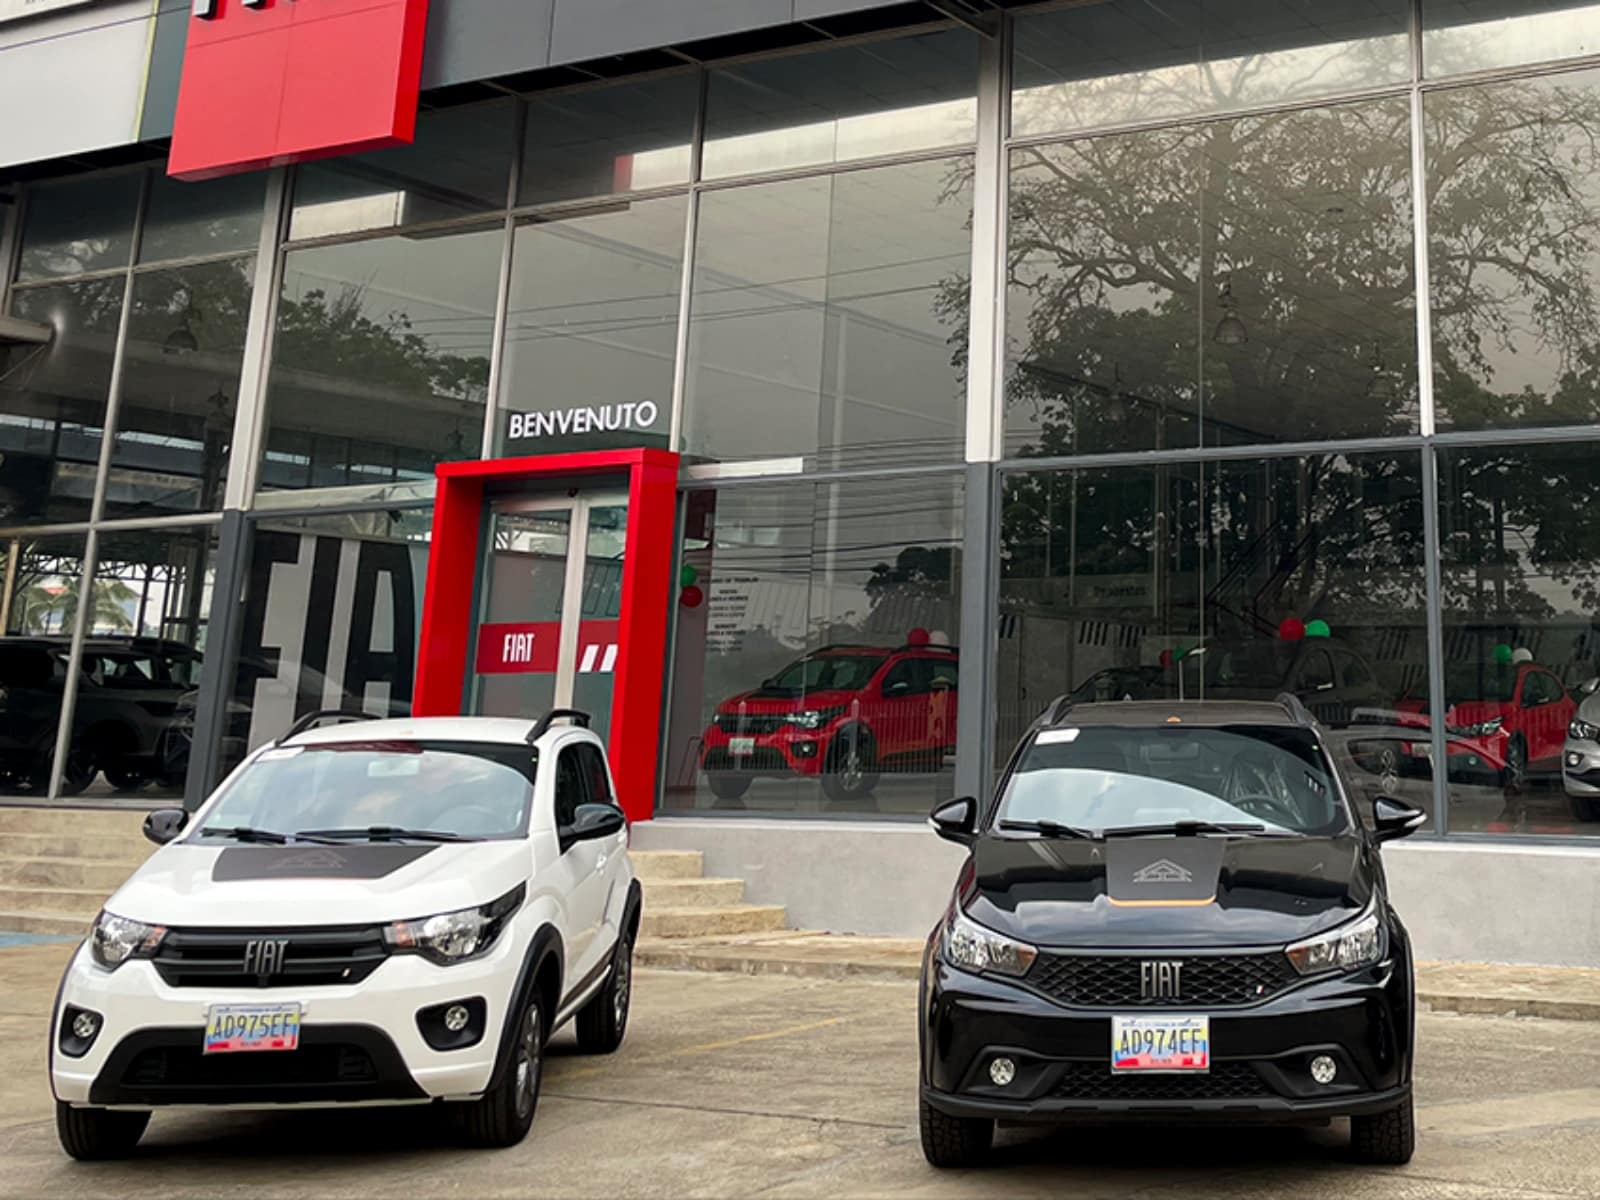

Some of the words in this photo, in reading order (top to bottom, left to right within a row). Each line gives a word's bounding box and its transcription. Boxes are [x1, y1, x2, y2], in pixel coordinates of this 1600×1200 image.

[508, 400, 657, 439] BENVENUTO
[502, 633, 535, 663] FIAT
[243, 940, 289, 974] FIAT
[1140, 961, 1184, 998] FIAT
[212, 1012, 295, 1039] AD975EF
[1120, 1028, 1202, 1055] AD974EF
